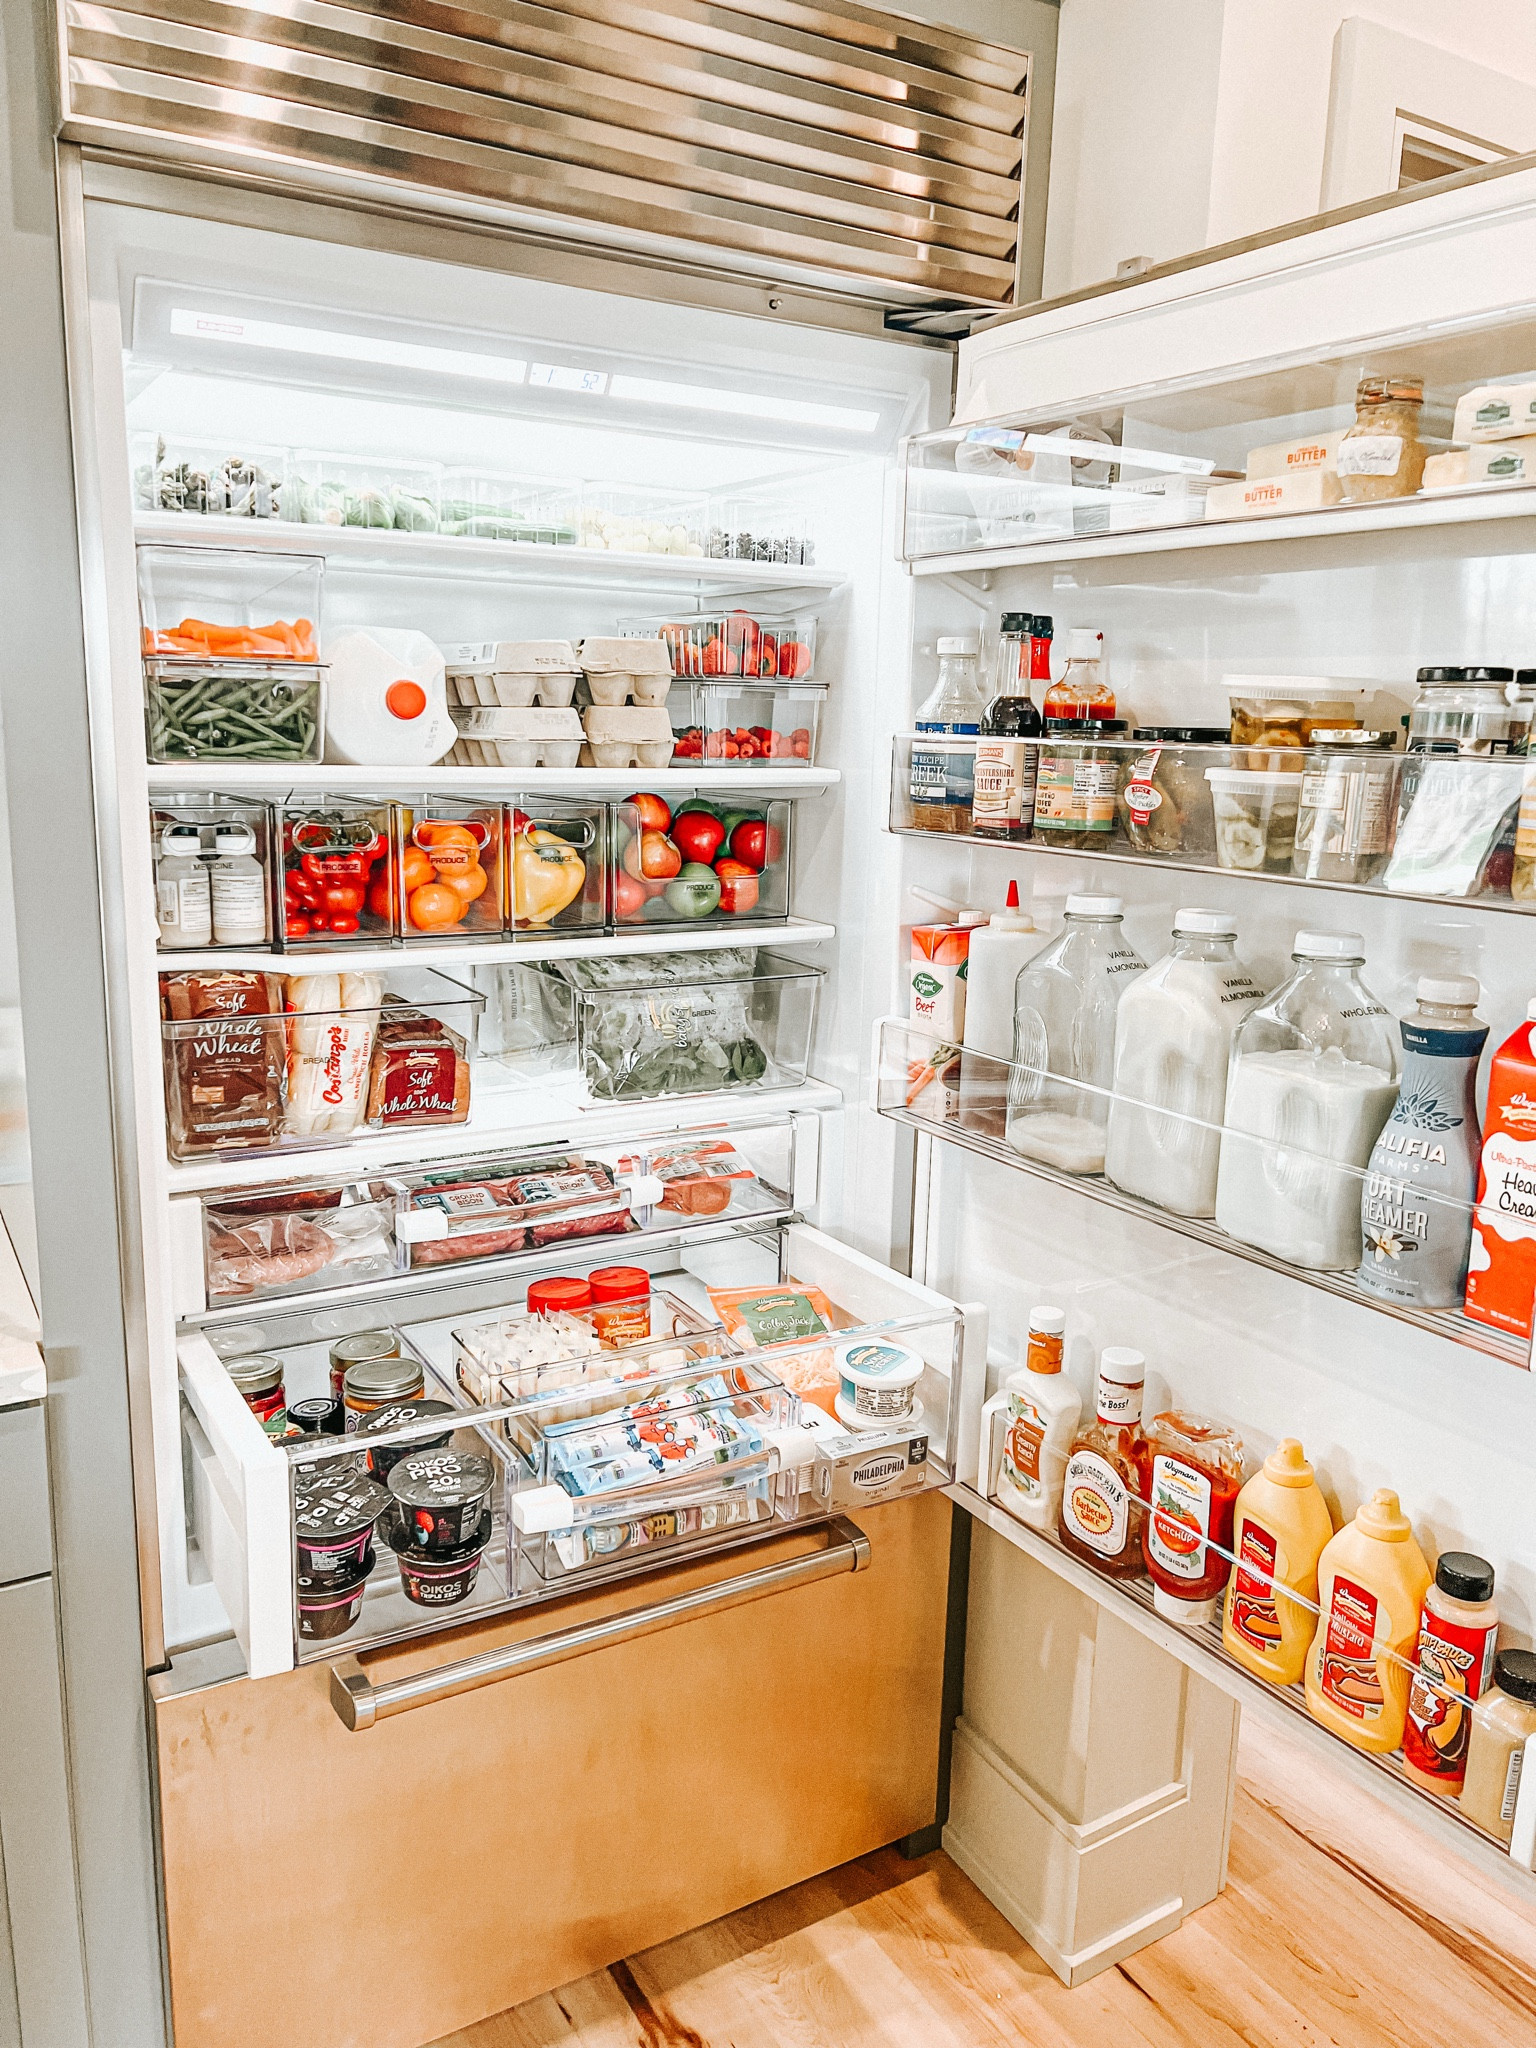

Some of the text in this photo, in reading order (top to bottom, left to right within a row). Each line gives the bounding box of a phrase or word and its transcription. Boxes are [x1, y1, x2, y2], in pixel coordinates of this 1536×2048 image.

[1287, 449, 1327, 464] BUTTER
[1244, 487, 1283, 502] BUTTER
[919, 755, 945, 765] RECIPE
[976, 778, 1002, 791] SAUCE
[428, 857, 466, 866] PRODUCE
[540, 855, 573, 863] PRODUCE
[193, 863, 234, 871] MEDICINE
[321, 863, 359, 871] PRODUCE
[685, 884, 715, 893] PRODUCE
[1107, 949, 1135, 960] VANILLA
[1106, 962, 1150, 975] ALMONDMILK
[915, 981, 936, 994] Organic
[1223, 978, 1254, 989] VANILLA
[215, 992, 247, 1013] Soft
[1220, 988, 1266, 1004] ALMONDMILK
[915, 997, 936, 1014] Beef
[1340, 1006, 1391, 1019] WHOLE MILK
[692, 1009, 717, 1018] GREENS
[198, 1019, 264, 1037] Whole
[674, 1018, 692, 1048] baby
[1405, 1033, 1428, 1044] VANILLA
[192, 1034, 263, 1059] Wheat
[322, 1025, 347, 1105] Costanzo's
[353, 1060, 368, 1100] SANDWICH
[407, 1069, 434, 1088] Soft
[377, 1093, 458, 1118] Whole Wheat
[1373, 1151, 1421, 1173] FARMS
[559, 1182, 584, 1191] BISON
[1368, 1173, 1406, 1206] OAT
[448, 1192, 485, 1202] GROUND
[457, 1197, 484, 1206] BISON
[1370, 1261, 1399, 1277] VANILLA
[758, 1315, 811, 1330] Colby Jack
[1107, 1398, 1129, 1410] Boss!
[1015, 1431, 1037, 1454] Creamy
[406, 1454, 457, 1471] OIKOS
[409, 1464, 461, 1481] PRO
[853, 1459, 905, 1484] PHILADELPHIA
[1163, 1460, 1198, 1482] Wegmans
[426, 1475, 462, 1489] 20g
[432, 1484, 461, 1493] PROTEIN
[864, 1485, 889, 1497] original
[1075, 1496, 1108, 1523] Barbecue
[1080, 1509, 1101, 1528] Sauce
[1157, 1520, 1193, 1543] KETCHUP
[1246, 1531, 1270, 1552] Wegmans
[420, 1580, 462, 1594] OIKOS
[420, 1588, 462, 1600] TRIPLE ZERO
[1339, 1588, 1369, 1610] Wegmans
[1333, 1607, 1358, 1631] Yellow
[1331, 1619, 1365, 1648] Mustard
[1437, 1643, 1472, 1667] SAUCE
